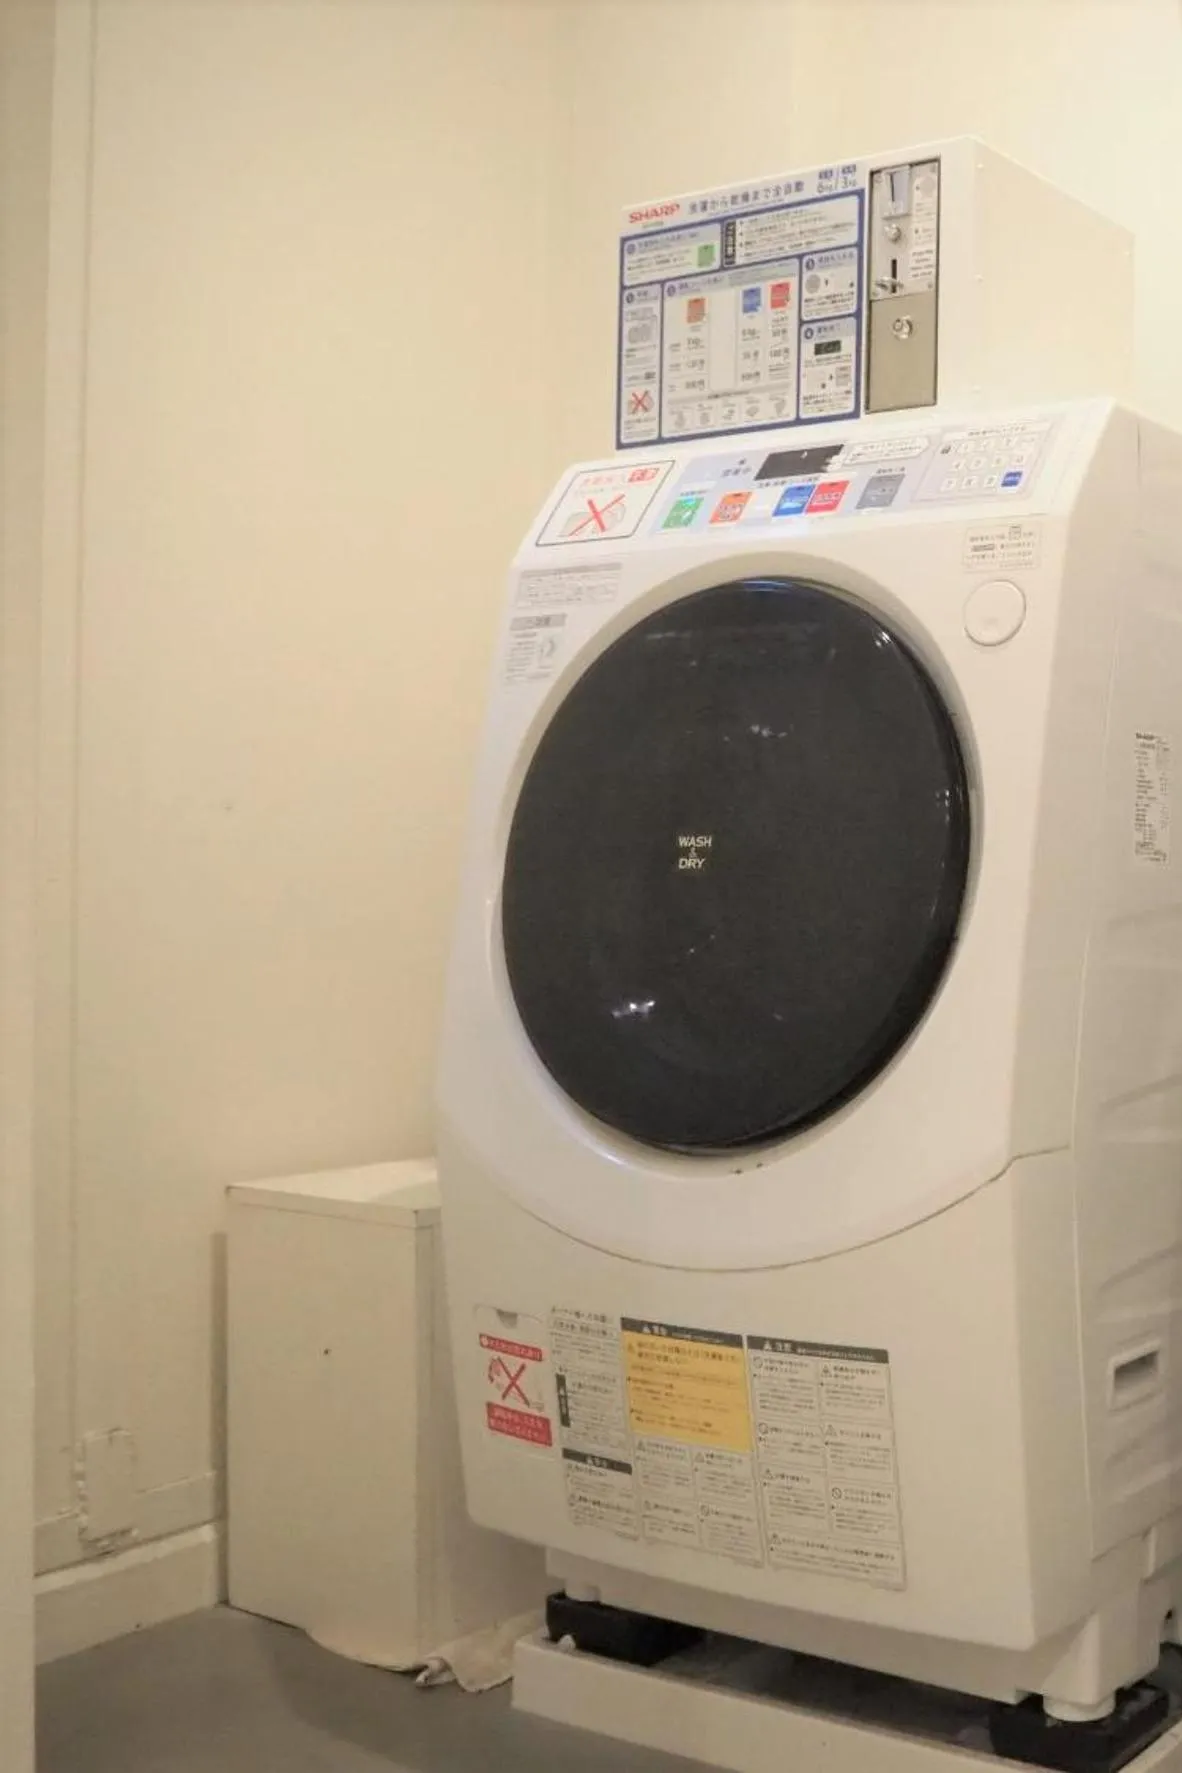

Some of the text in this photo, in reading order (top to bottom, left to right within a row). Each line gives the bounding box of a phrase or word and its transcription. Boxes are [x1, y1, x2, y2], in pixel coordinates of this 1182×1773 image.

[628, 202, 681, 223] SHARP
[678, 835, 712, 847] WASH
[678, 857, 706, 869] DRY
